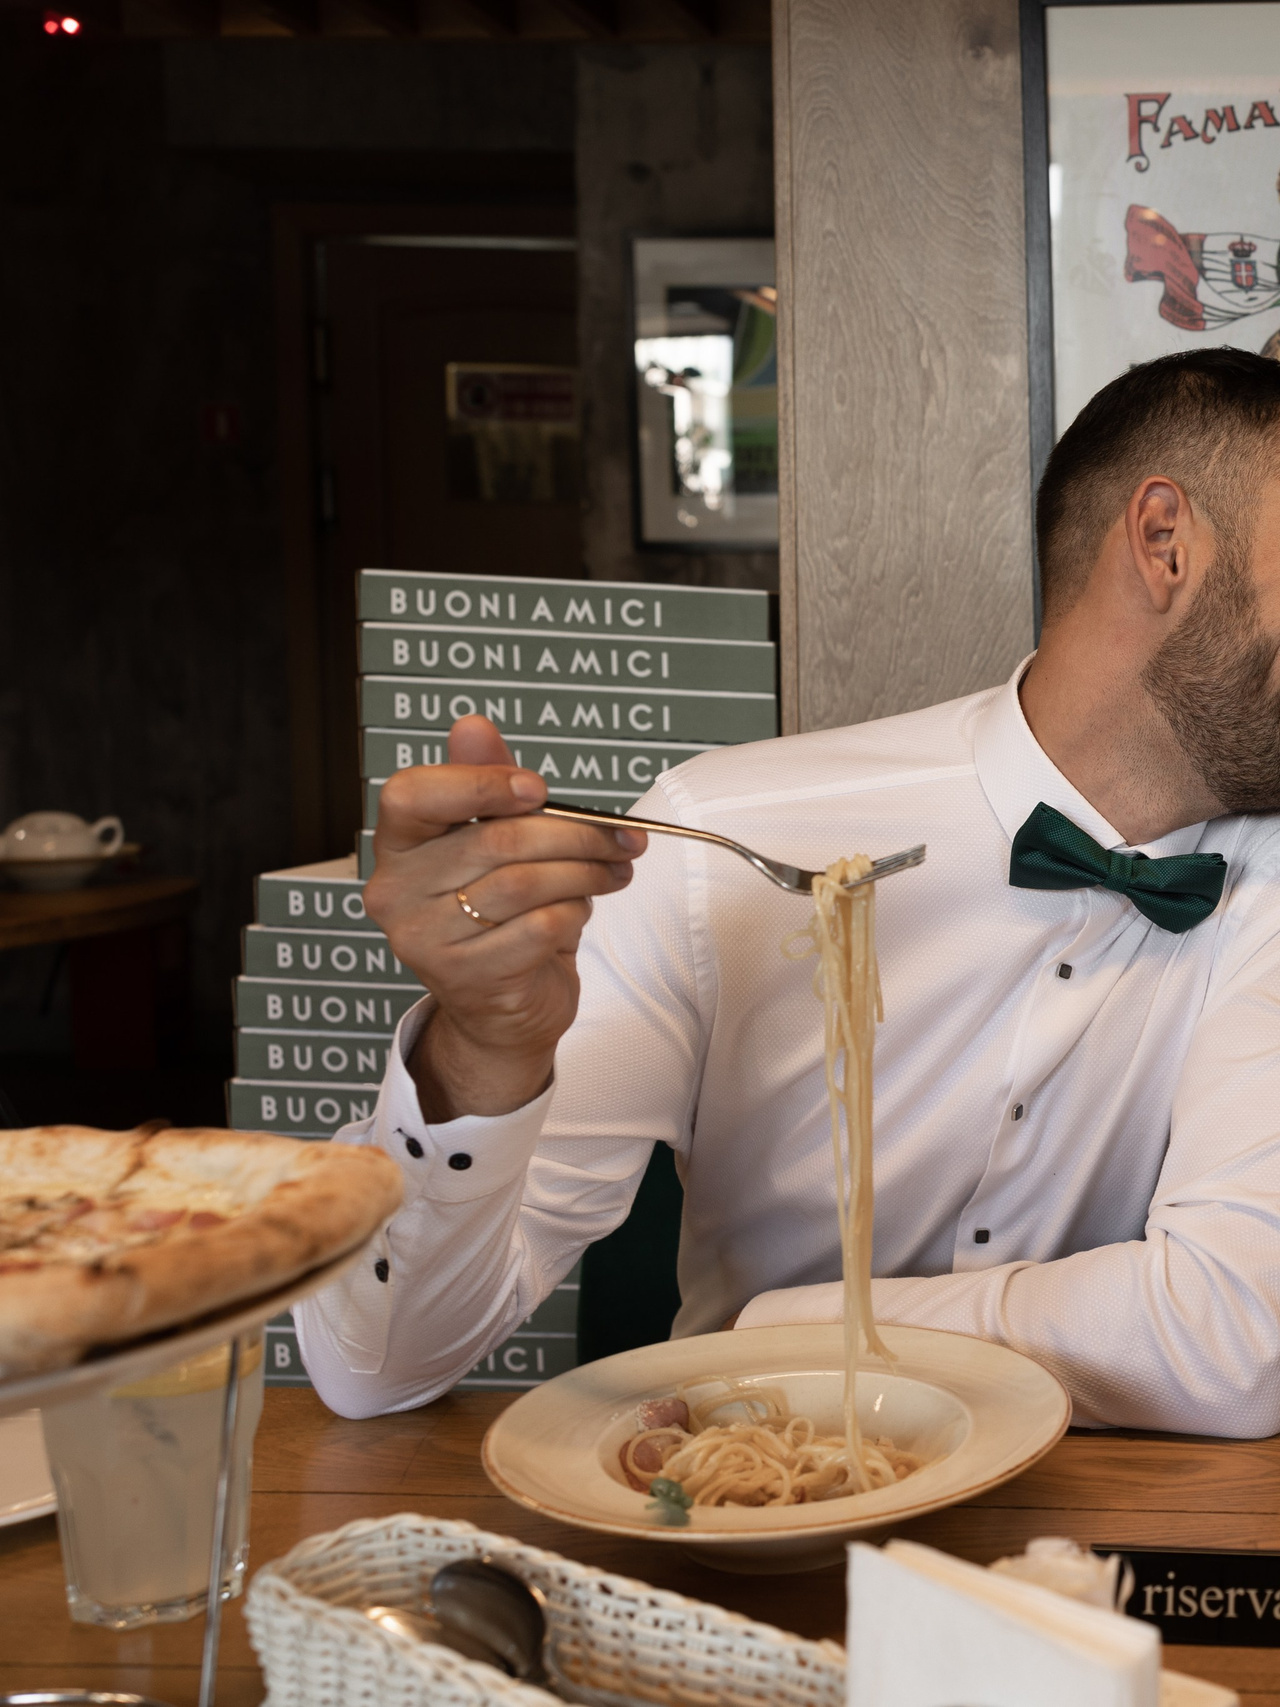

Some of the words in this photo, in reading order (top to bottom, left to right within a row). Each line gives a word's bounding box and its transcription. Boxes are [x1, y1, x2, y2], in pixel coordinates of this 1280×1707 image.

[1124, 92, 1280, 173] FAMA
[390, 587, 516, 621] BUONI
[530, 595, 662, 628] AMICI
[393, 638, 522, 672] BUONI
[536, 647, 670, 679] AMICI
[394, 692, 523, 725] BUONI
[537, 700, 671, 732] AMICI
[288, 890, 365, 920] BUO
[276, 942, 402, 975] BUONI
[266, 993, 392, 1025] BUONI
[261, 1096, 371, 1124] BUON
